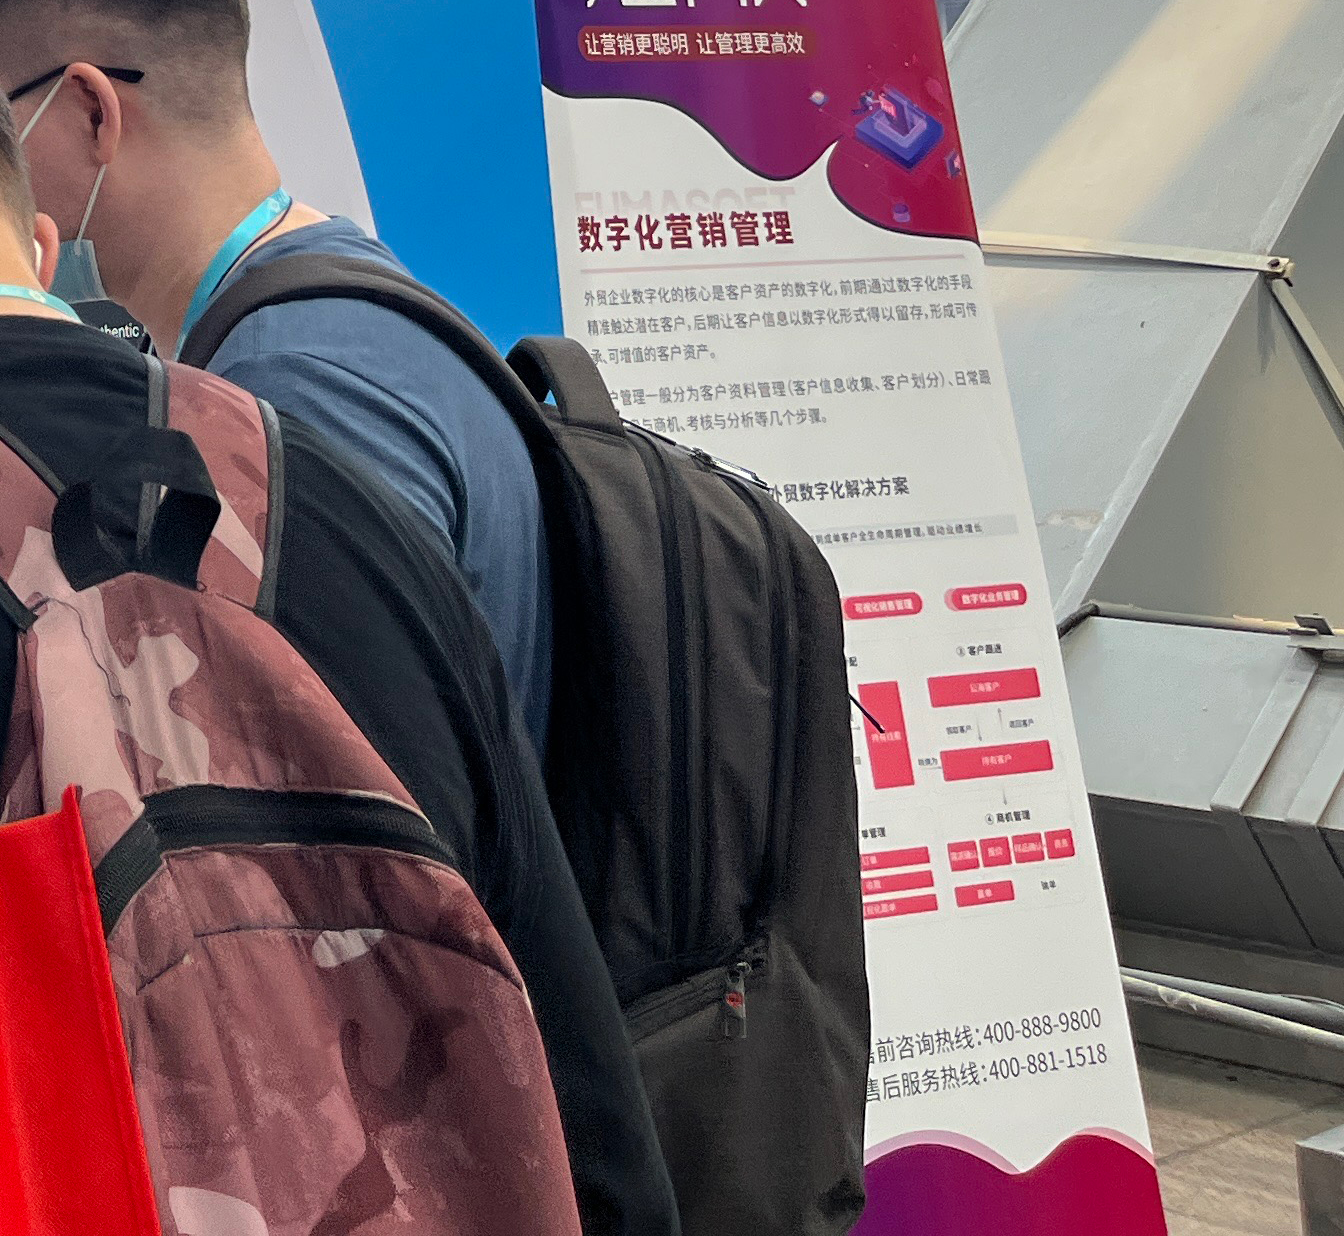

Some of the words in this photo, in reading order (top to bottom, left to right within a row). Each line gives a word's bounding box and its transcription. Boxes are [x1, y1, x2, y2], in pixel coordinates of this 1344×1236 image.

[584, 32, 690, 56] 让营销更聪明
[695, 31, 806, 55] 让管理更高效
[576, 210, 795, 253] 数字化营销管理
